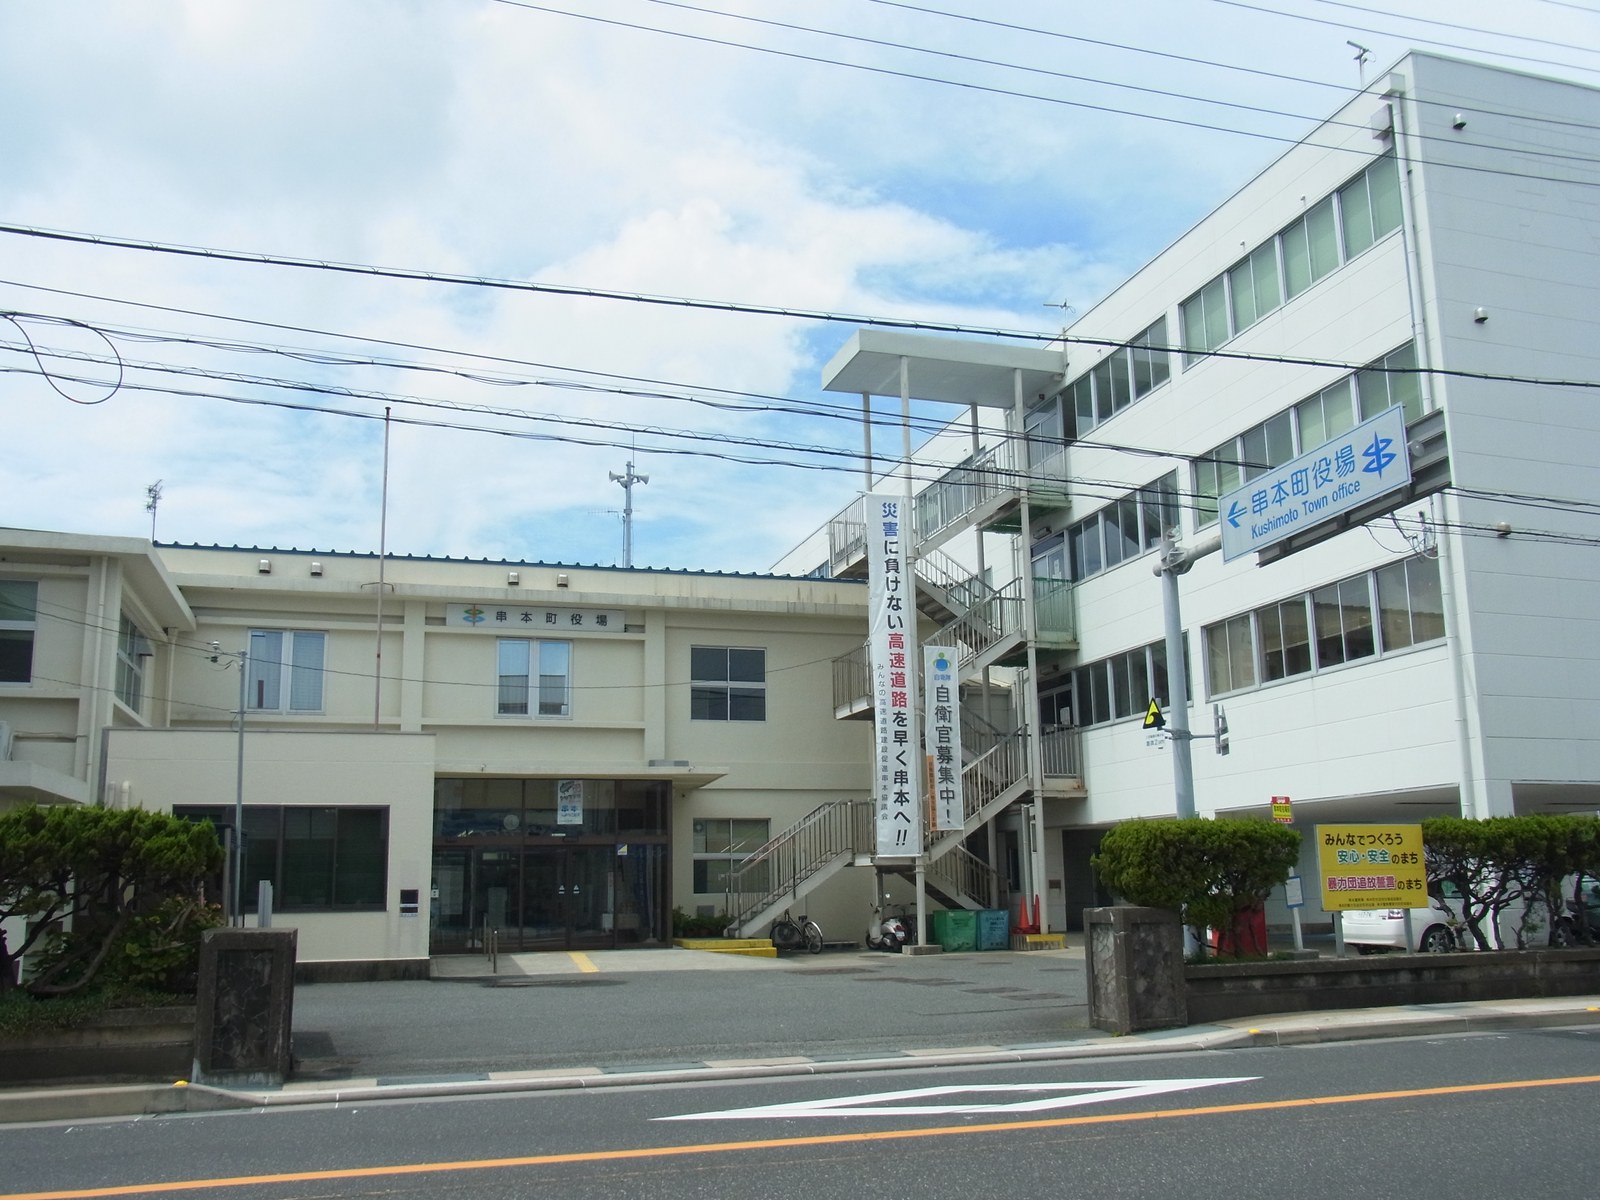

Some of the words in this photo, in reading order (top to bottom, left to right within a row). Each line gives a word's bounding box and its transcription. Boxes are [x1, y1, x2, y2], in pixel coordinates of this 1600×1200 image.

[1252, 444, 1356, 516] 串本町役場
[1251, 509, 1299, 539] Kushimoto
[1302, 494, 1329, 516] Town
[1332, 480, 1361, 501] office
[496, 610, 608, 627] 串本町役場
[1325, 833, 1403, 846] みんなでつくろう
